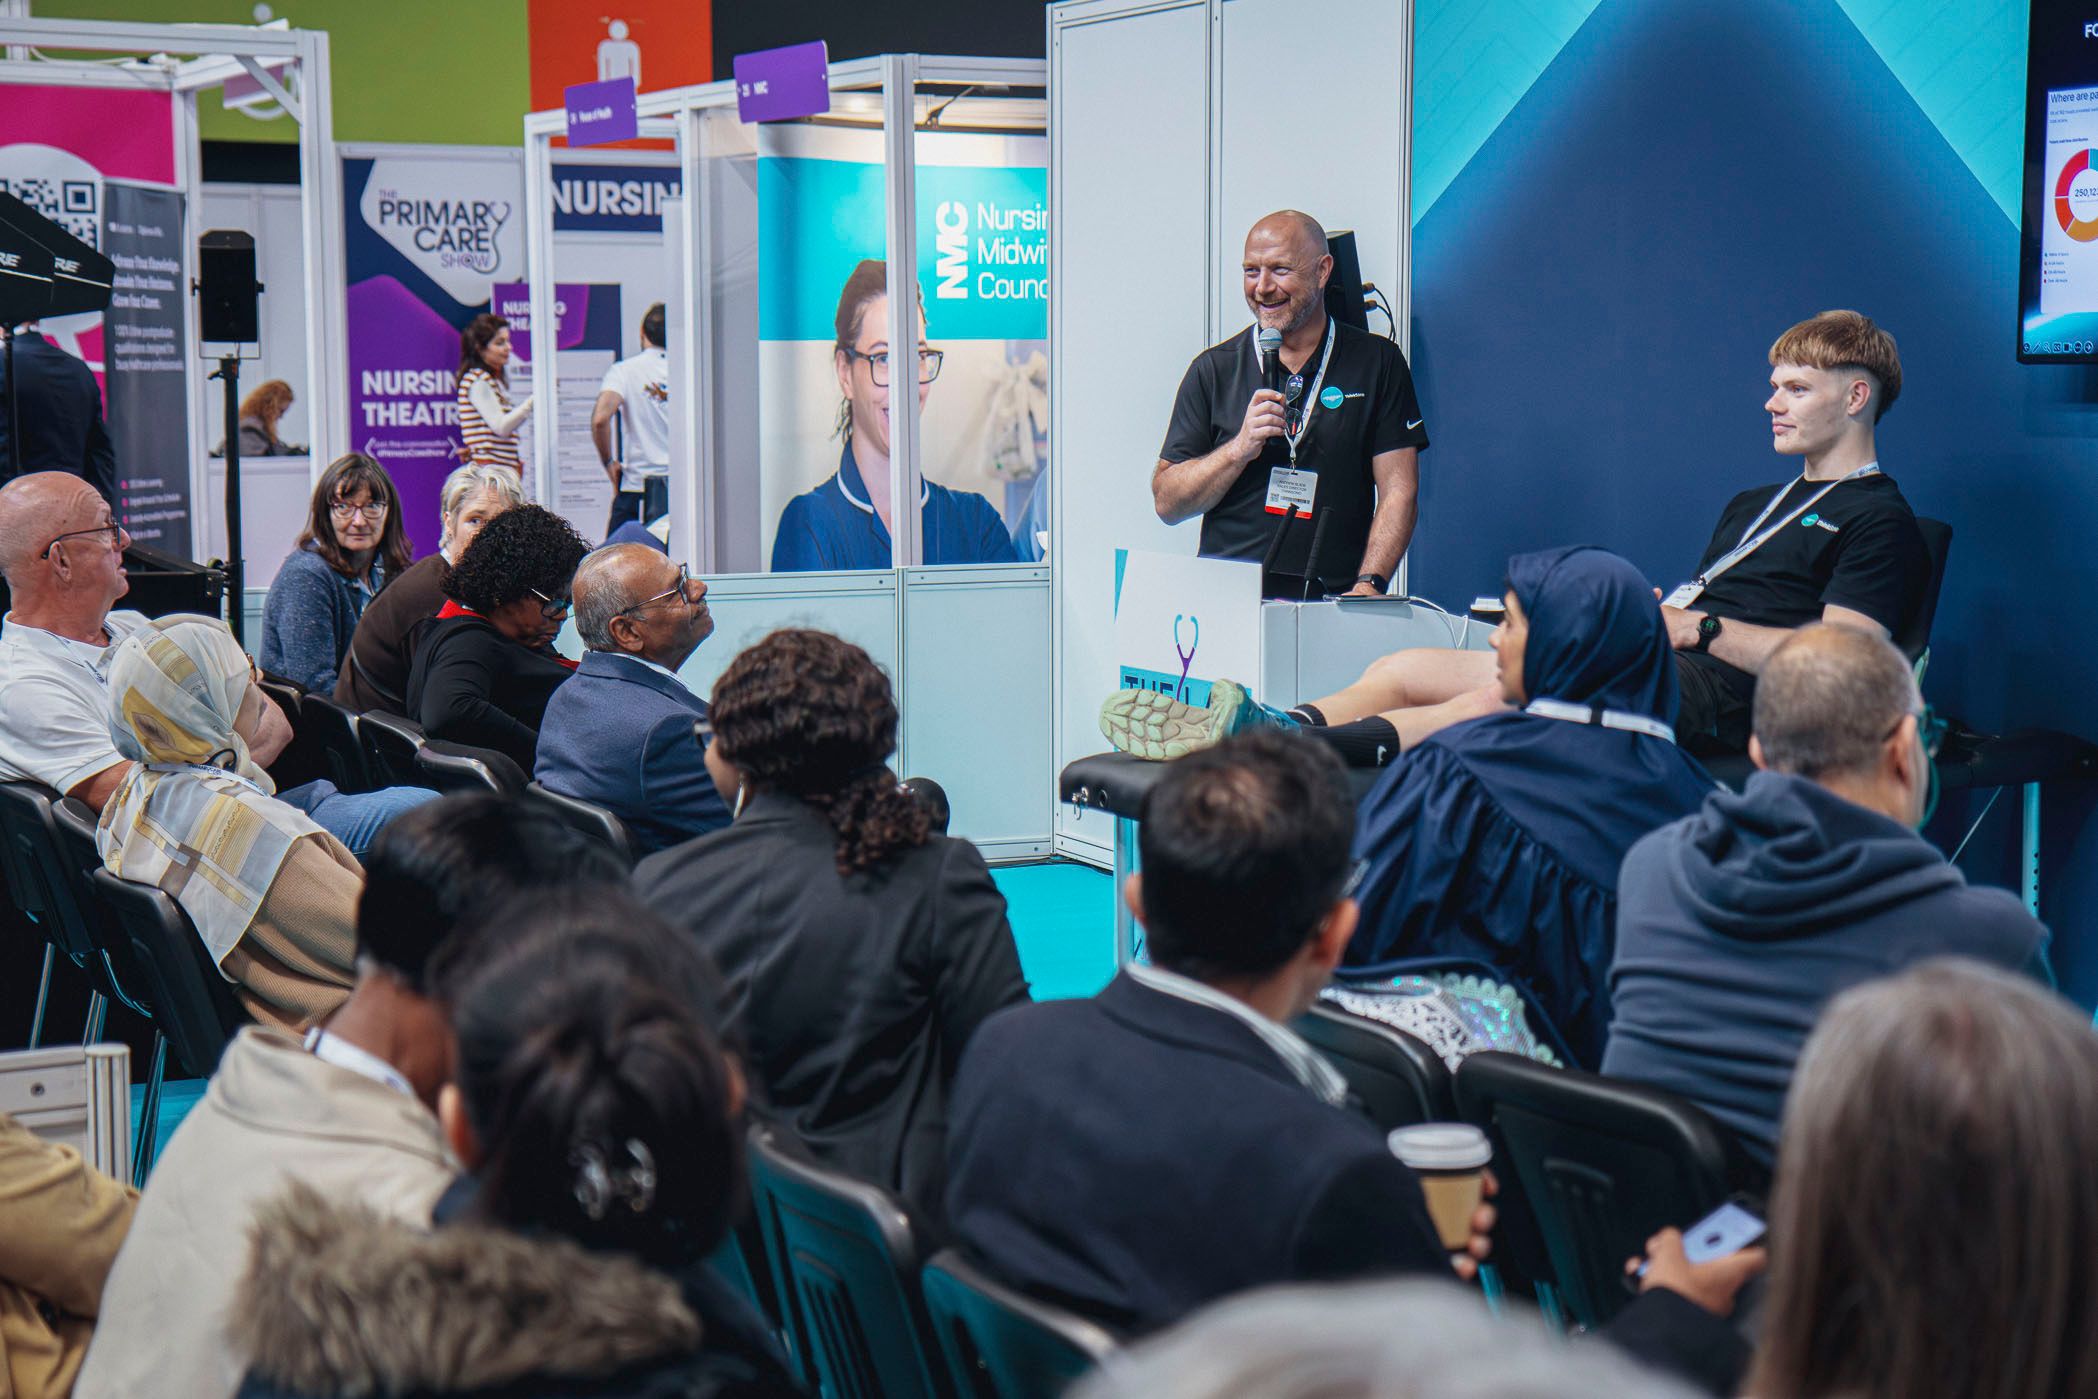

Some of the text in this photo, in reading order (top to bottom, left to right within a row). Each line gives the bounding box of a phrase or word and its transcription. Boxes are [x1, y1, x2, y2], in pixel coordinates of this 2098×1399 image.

[2050, 93, 2075, 103] Where
[2076, 92, 2088, 101] are
[379, 189, 398, 199] THE
[379, 200, 512, 226] PRIMARY
[414, 225, 490, 252] CARE
[936, 200, 968, 299] NMC
[977, 237, 1048, 265] Midwi
[440, 253, 491, 269] SHOW
